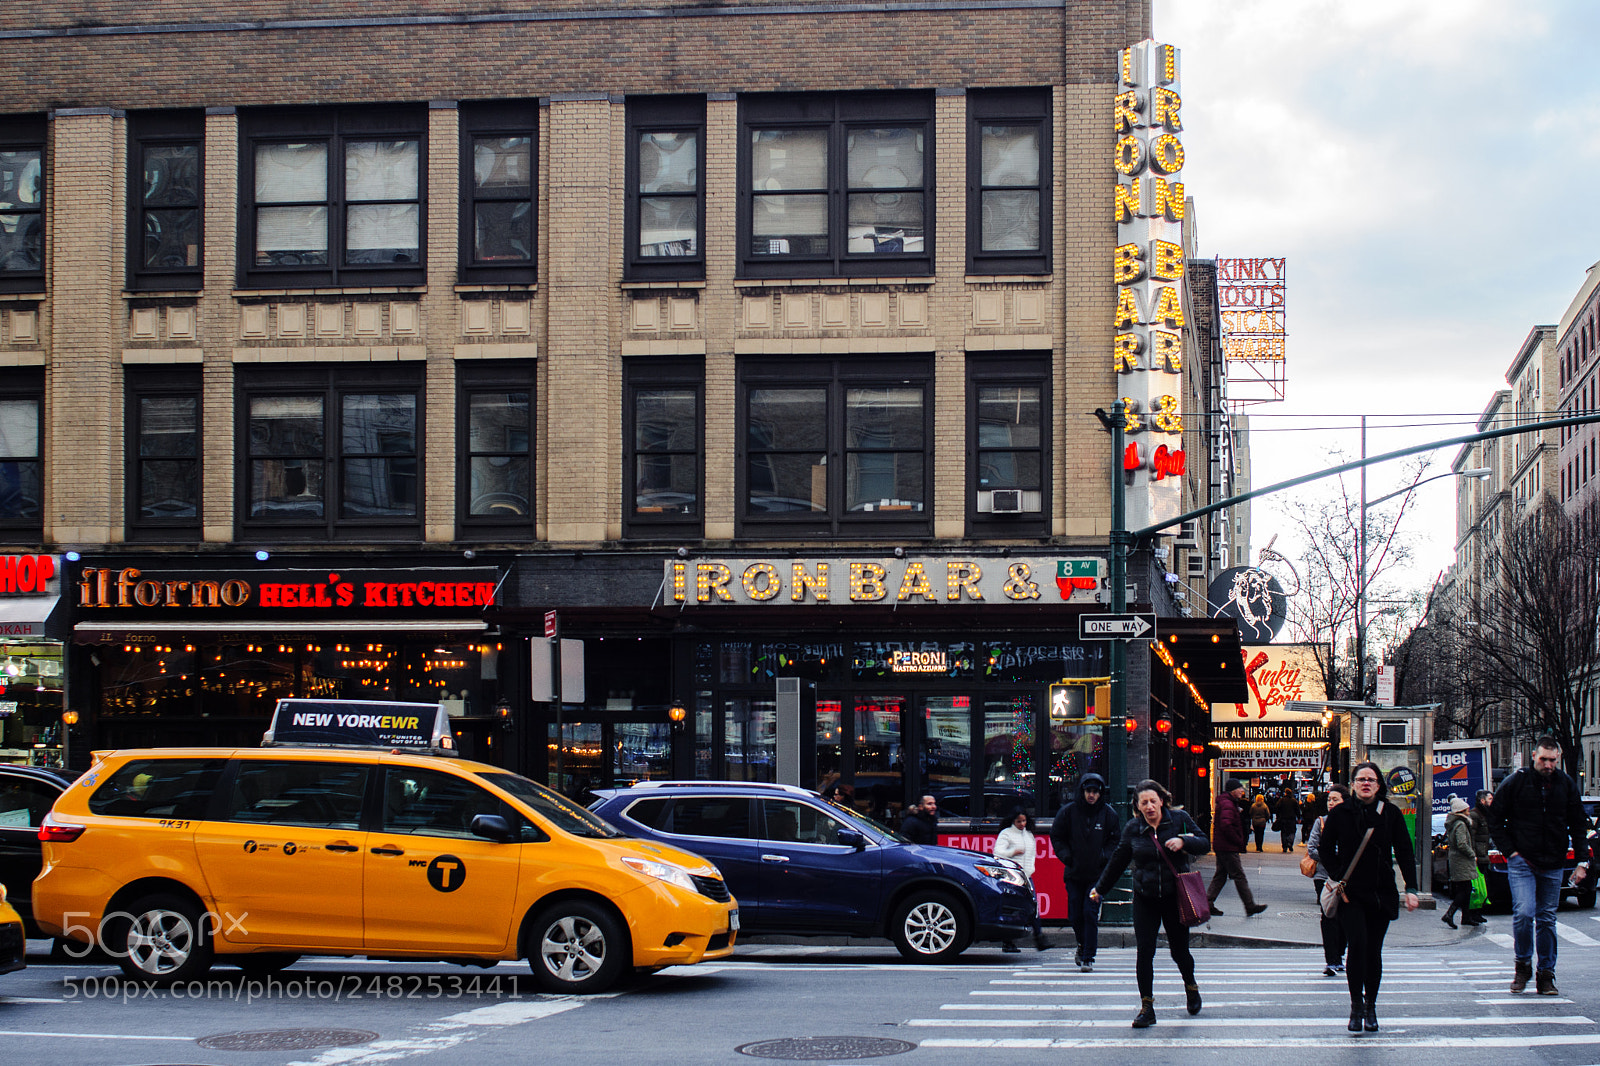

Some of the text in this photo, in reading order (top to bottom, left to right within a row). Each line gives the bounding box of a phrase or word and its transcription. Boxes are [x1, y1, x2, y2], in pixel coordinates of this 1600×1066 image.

[1153, 44, 1184, 222] IRON
[1219, 258, 1285, 280] KINKY
[1153, 239, 1185, 373] BAR
[1155, 395, 1184, 433] &
[1063, 561, 1091, 576] 8 AV
[674, 563, 830, 601] IRON
[850, 562, 985, 602] BAR
[1003, 562, 1041, 601] &
[259, 573, 354, 607] HELL'S
[364, 582, 495, 607] KITCHEN
[1090, 622, 1144, 632] ONE WAY
[893, 651, 946, 665] PERONI
[292, 713, 334, 727] NEW
[1214, 726, 1330, 739] THE AL HIRSCHFELD THEATRE
[1219, 749, 1320, 759] WINNER! 6 TONY AWARDS
[1221, 758, 1319, 768] BEST MUSICAL!
[159, 820, 190, 829] 9K31
[437, 862, 458, 888] T
